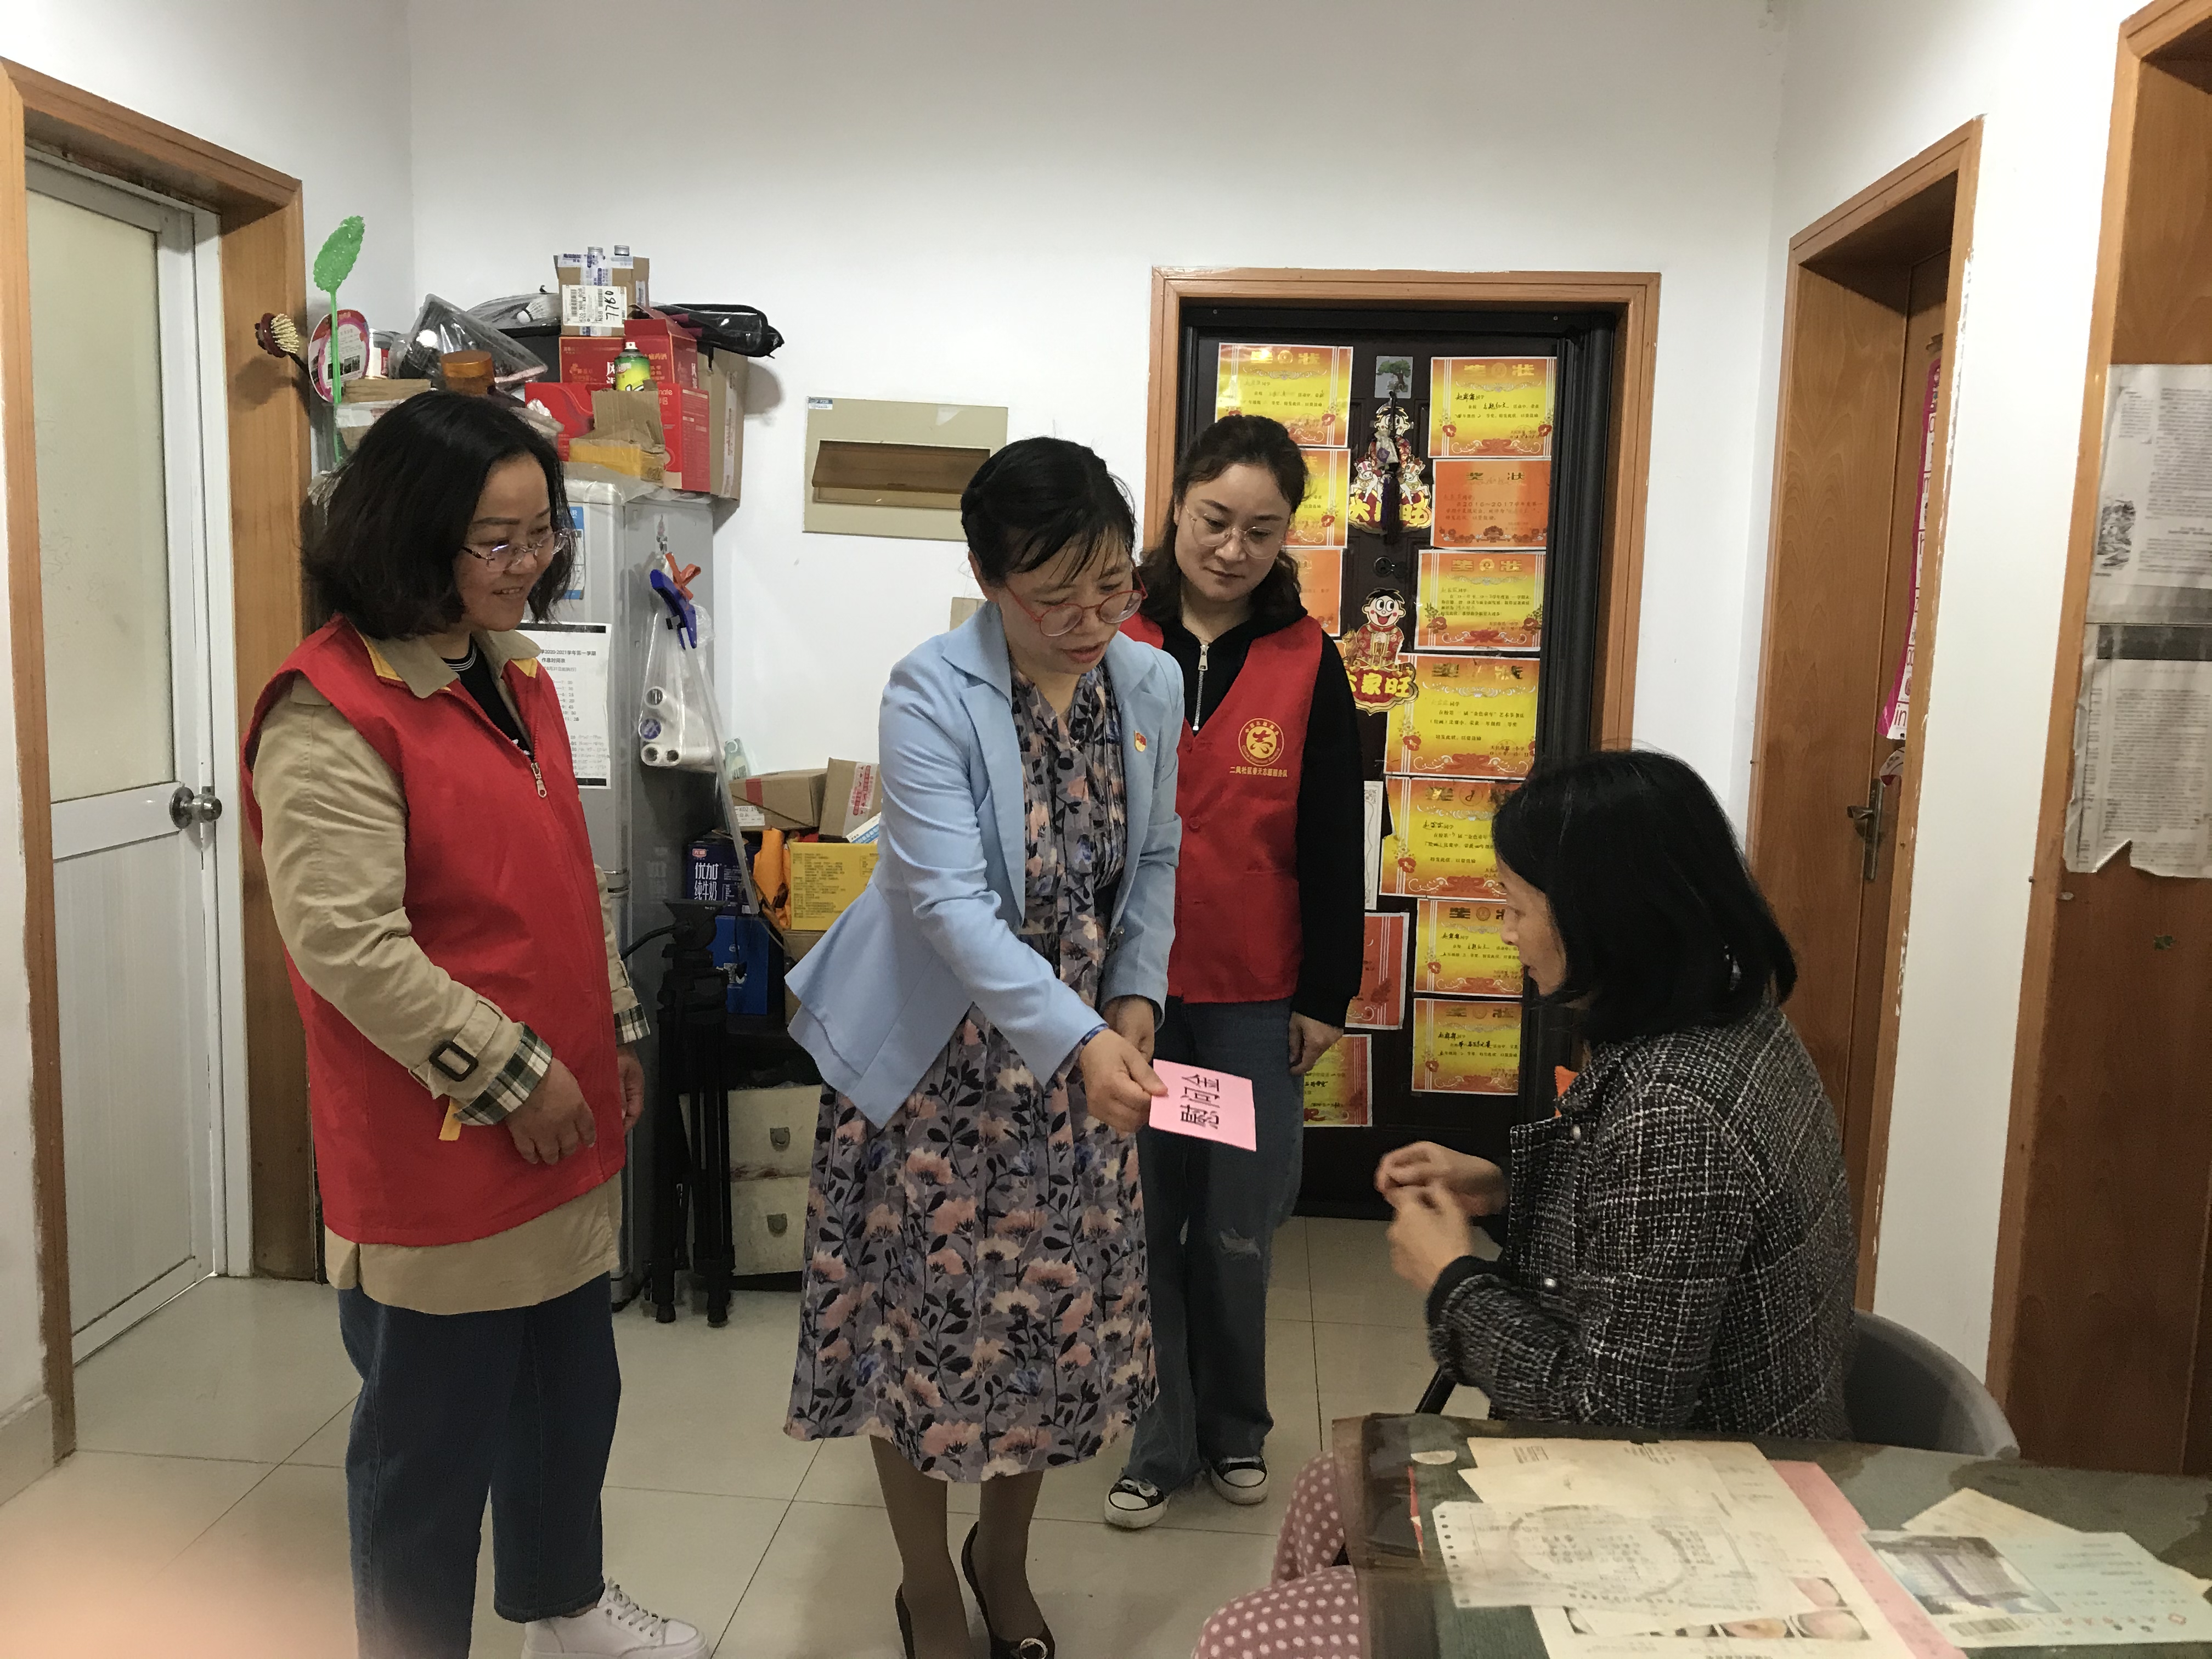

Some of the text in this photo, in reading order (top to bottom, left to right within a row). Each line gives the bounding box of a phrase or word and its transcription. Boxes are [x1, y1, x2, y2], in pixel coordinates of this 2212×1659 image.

[1348, 499, 1425, 524] 大旺
[695, 862, 719, 880] 优加
[694, 879, 717, 901] 纯牛奶
